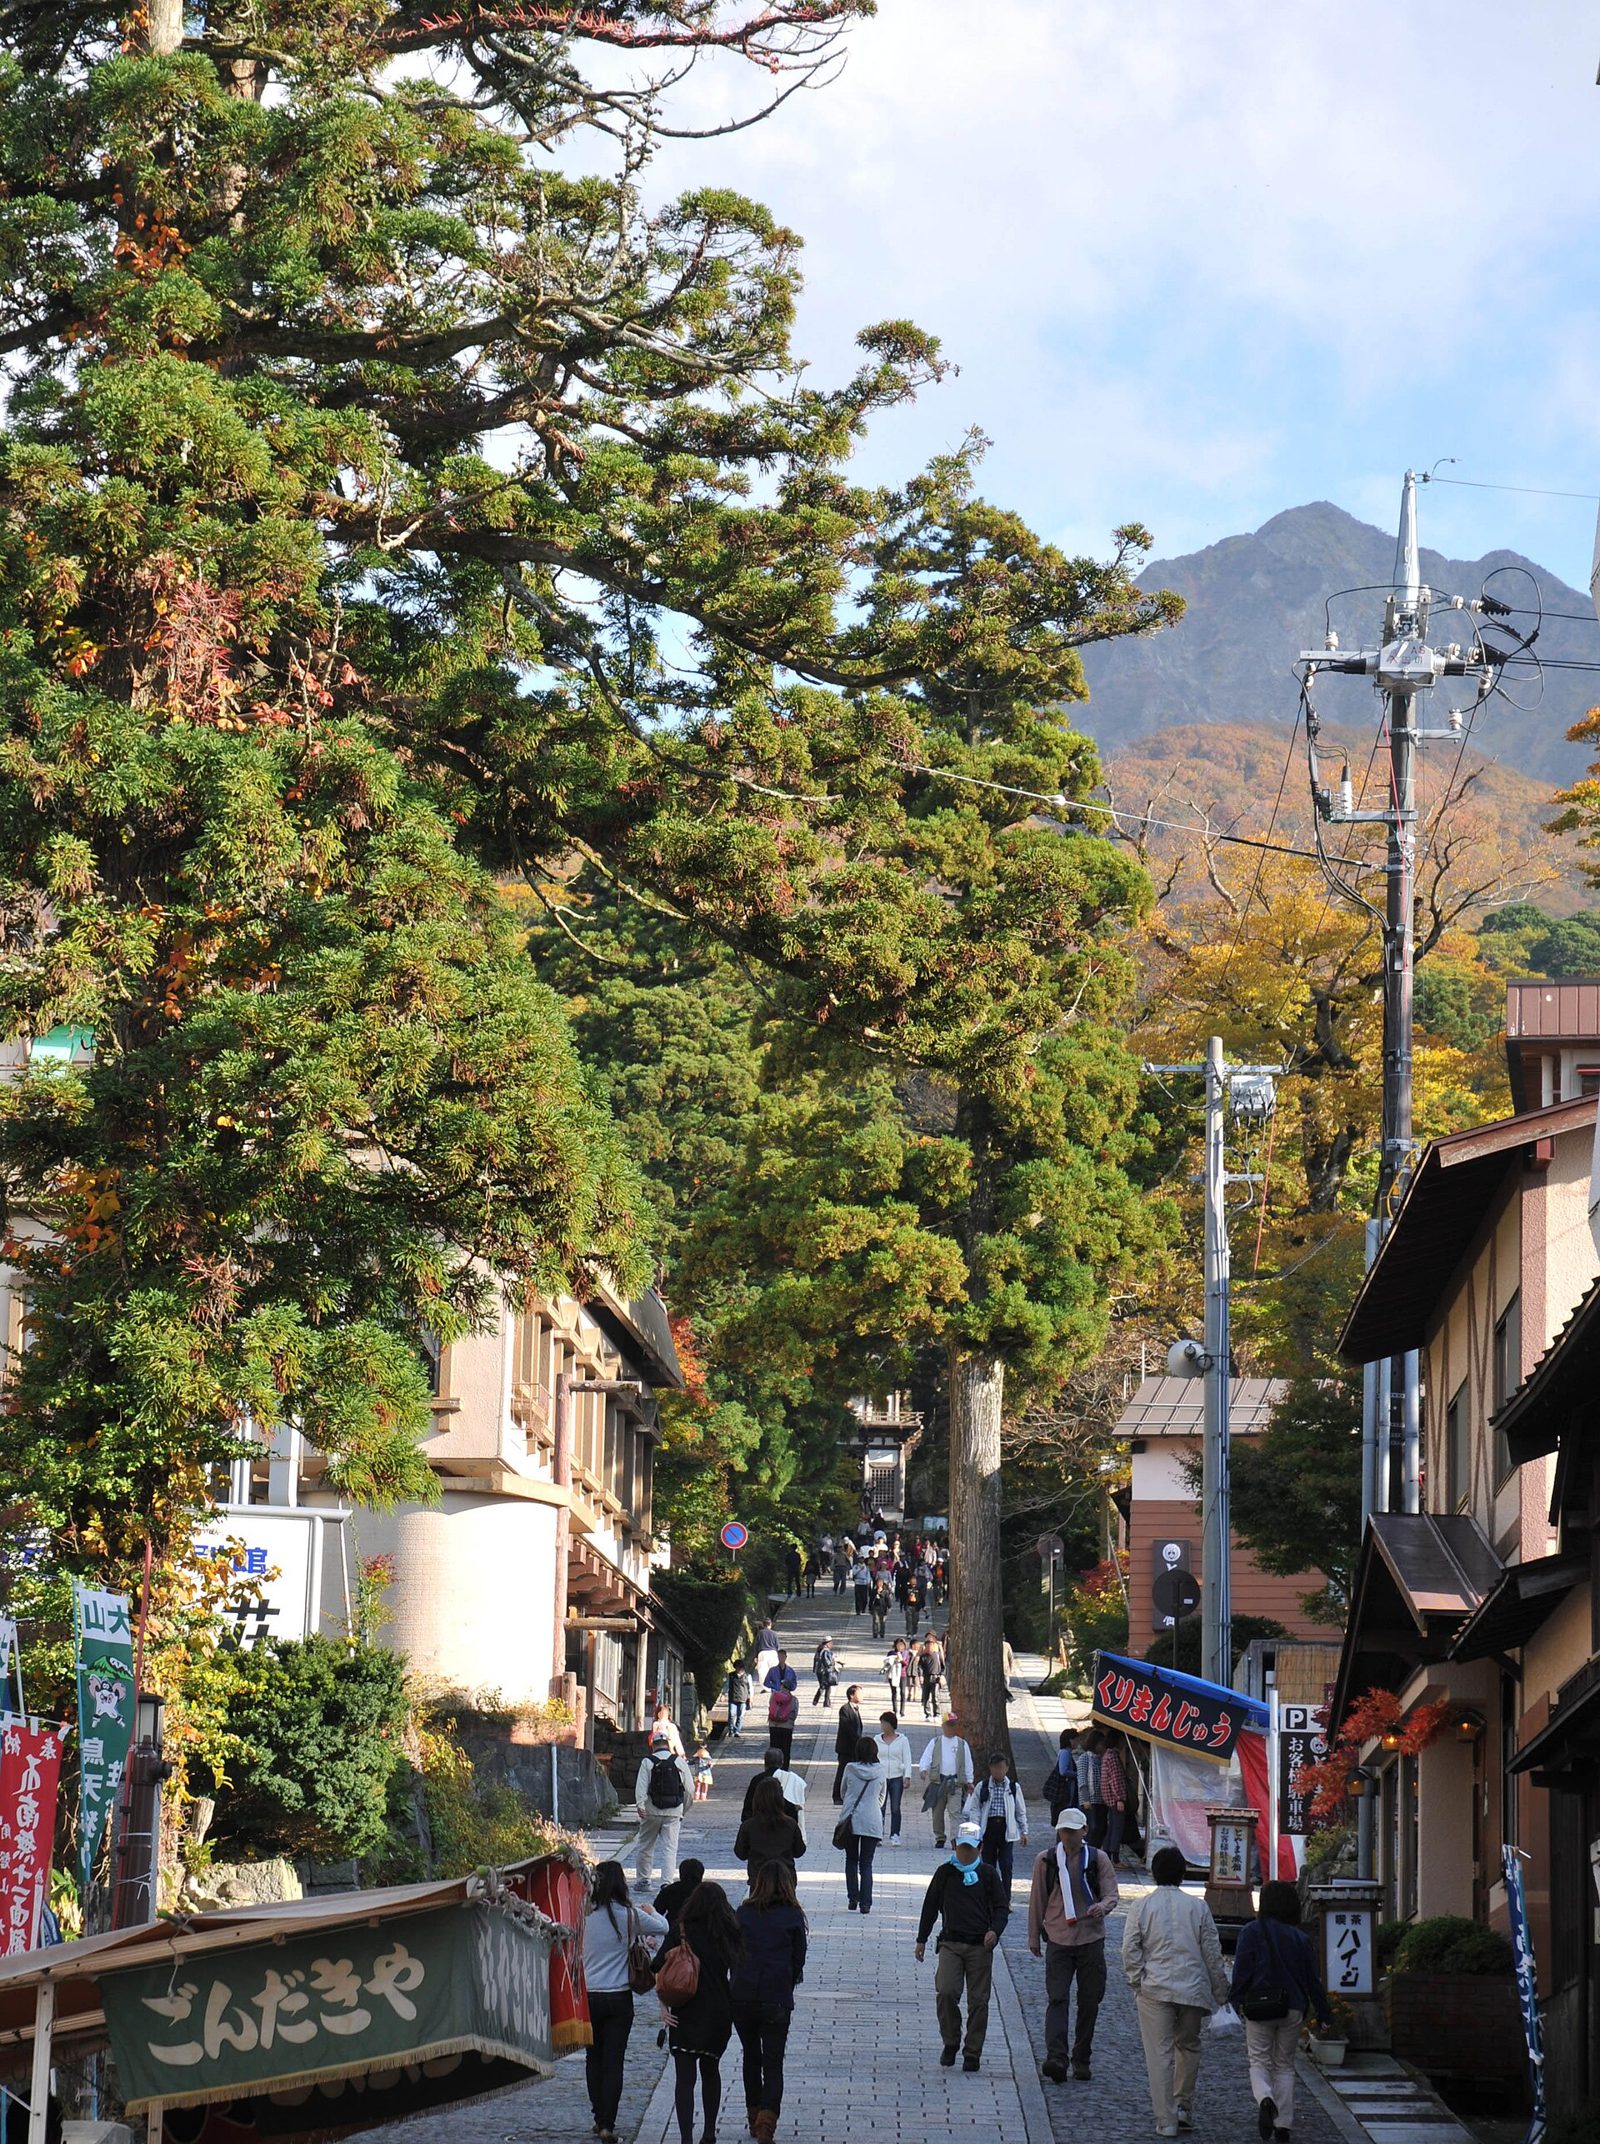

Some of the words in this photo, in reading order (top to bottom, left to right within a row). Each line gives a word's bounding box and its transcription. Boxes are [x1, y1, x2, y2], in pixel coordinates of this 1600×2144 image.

[1097, 1670, 1232, 1747] くりまんじゅう
[1289, 1709, 1304, 1728] P
[1335, 1914, 1361, 1926] 喫茶
